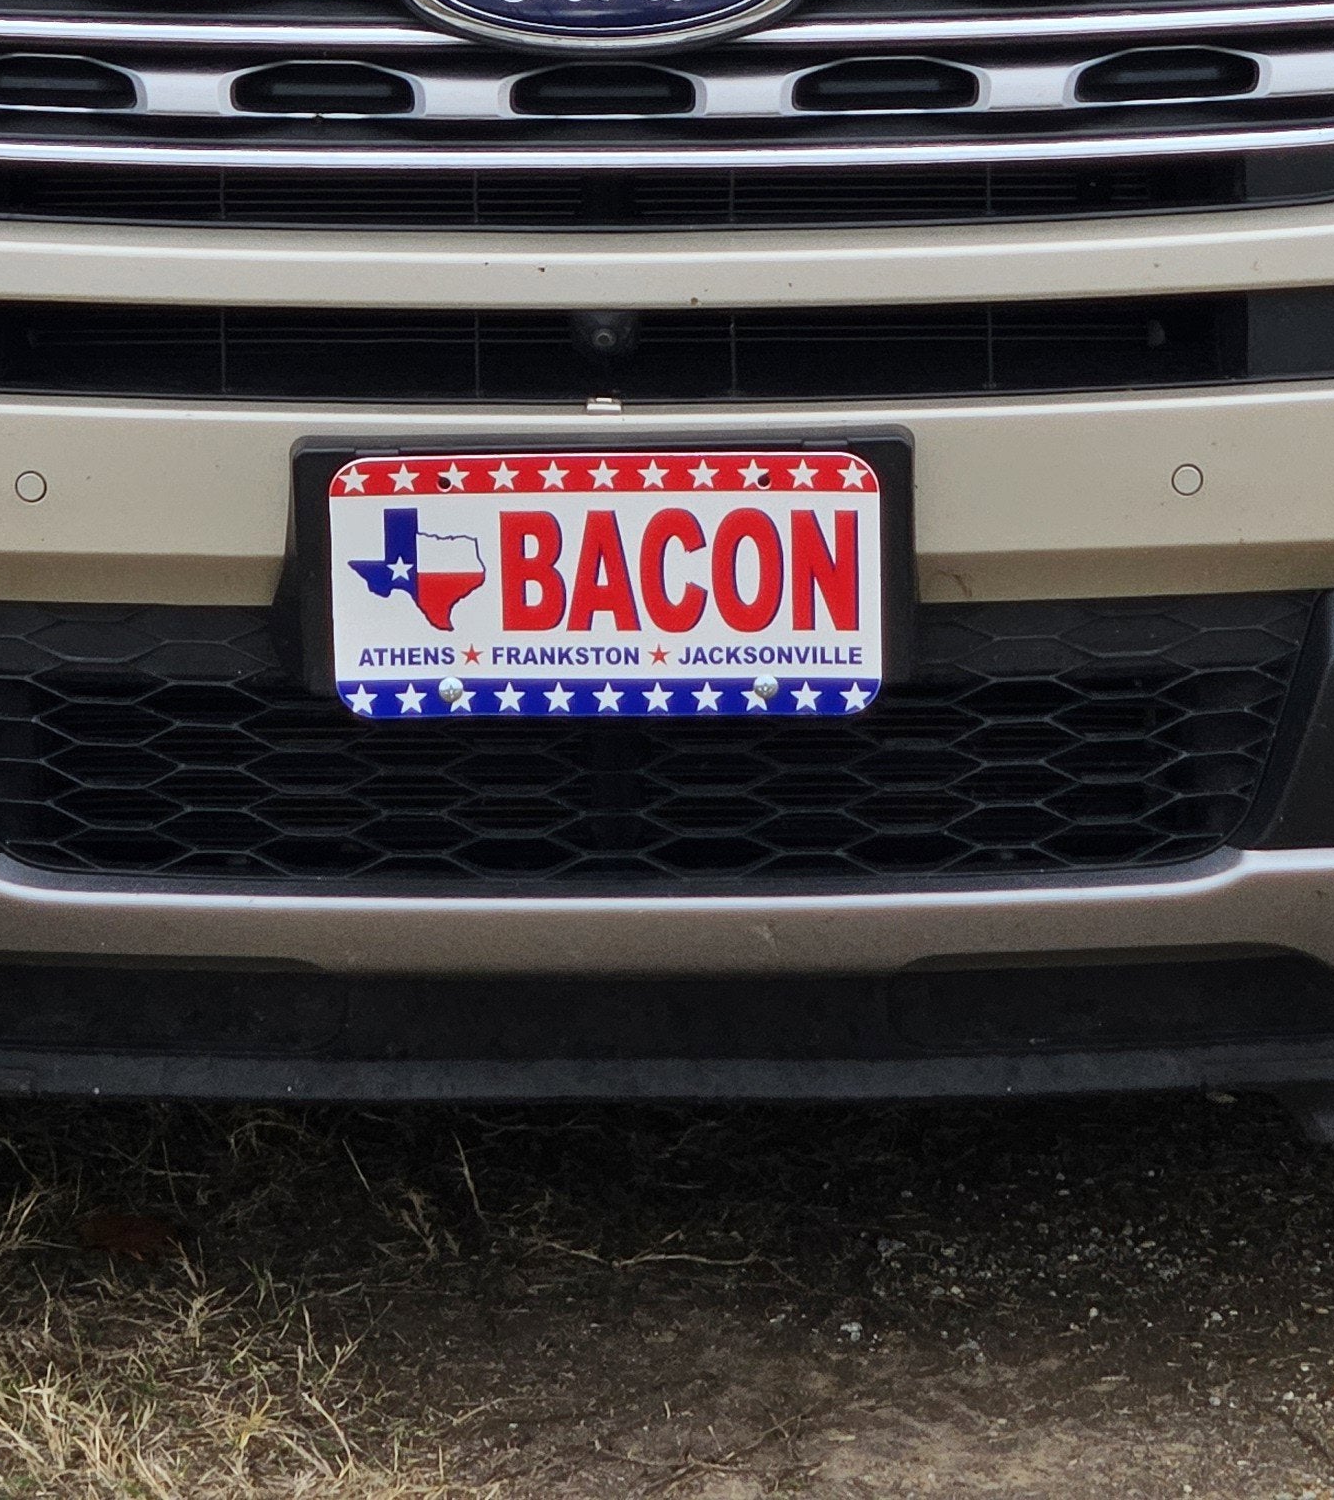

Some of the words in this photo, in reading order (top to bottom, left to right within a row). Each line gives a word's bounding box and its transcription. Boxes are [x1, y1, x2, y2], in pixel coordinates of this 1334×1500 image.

[499, 508, 860, 633] BACON
[358, 646, 456, 667] ATHENS
[491, 645, 641, 666] FRANKSTON
[677, 645, 863, 666] JACKSONVILLE
